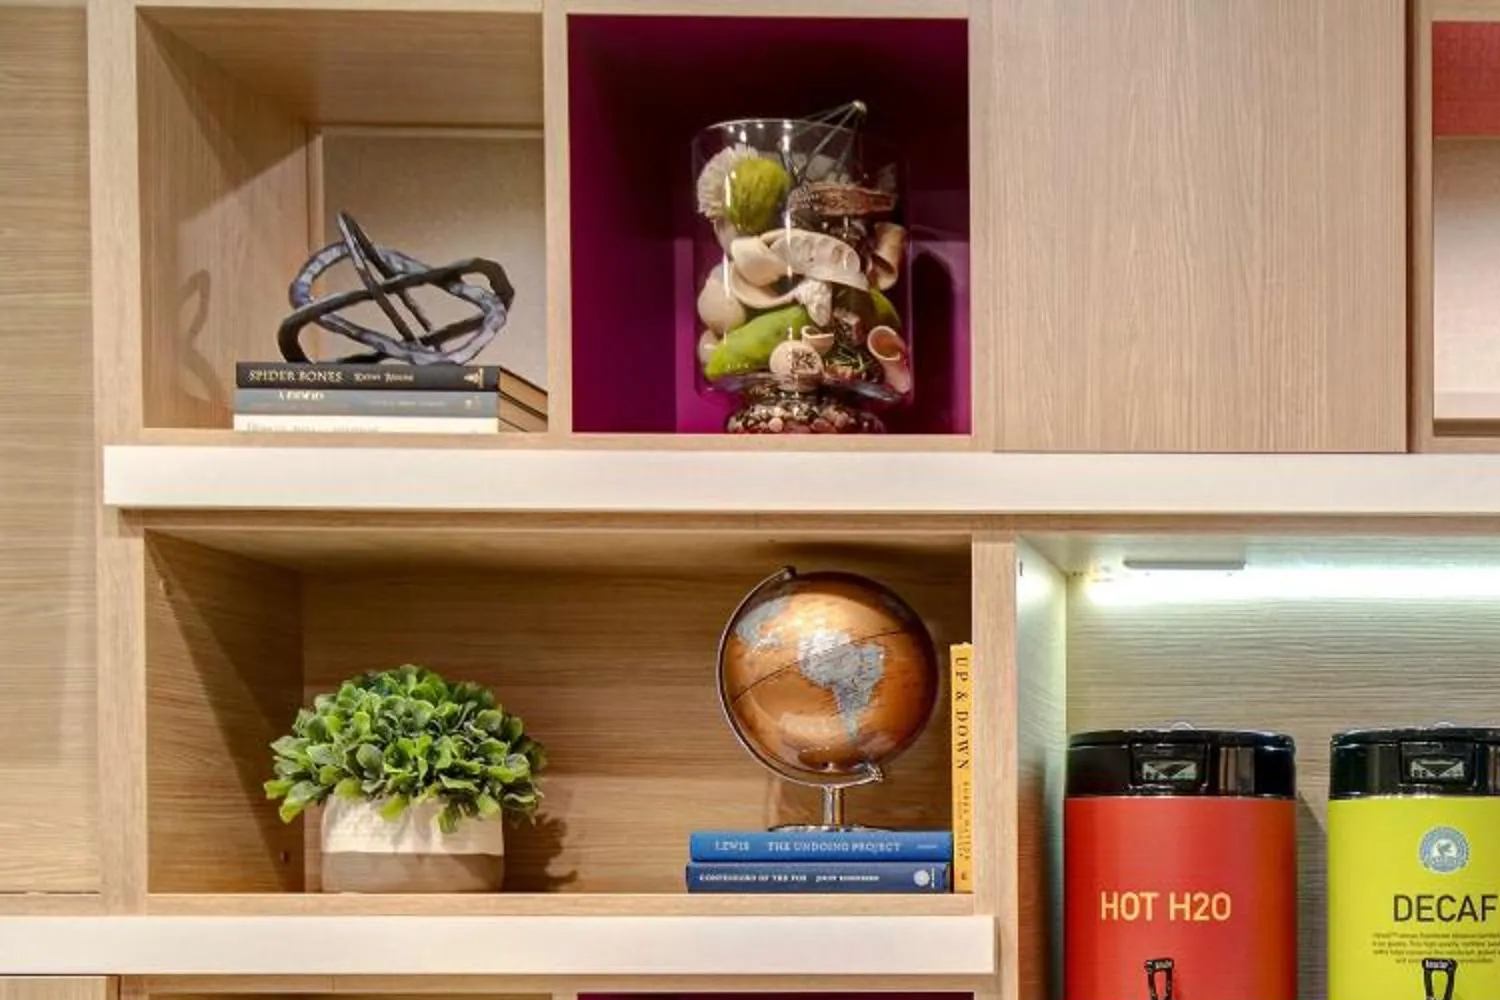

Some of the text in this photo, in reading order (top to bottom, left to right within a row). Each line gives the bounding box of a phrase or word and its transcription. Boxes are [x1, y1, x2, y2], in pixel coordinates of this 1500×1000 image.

[249, 369, 295, 382] SPIDER
[300, 370, 343, 382] BONES
[955, 656, 968, 683] UP
[955, 690, 968, 701] &
[955, 711, 968, 770] DOWN
[714, 841, 901, 852] LEWIS THE UNDOING PROJECT
[1100, 891, 1160, 921] HOT
[1393, 894, 1498, 922] DECAF
